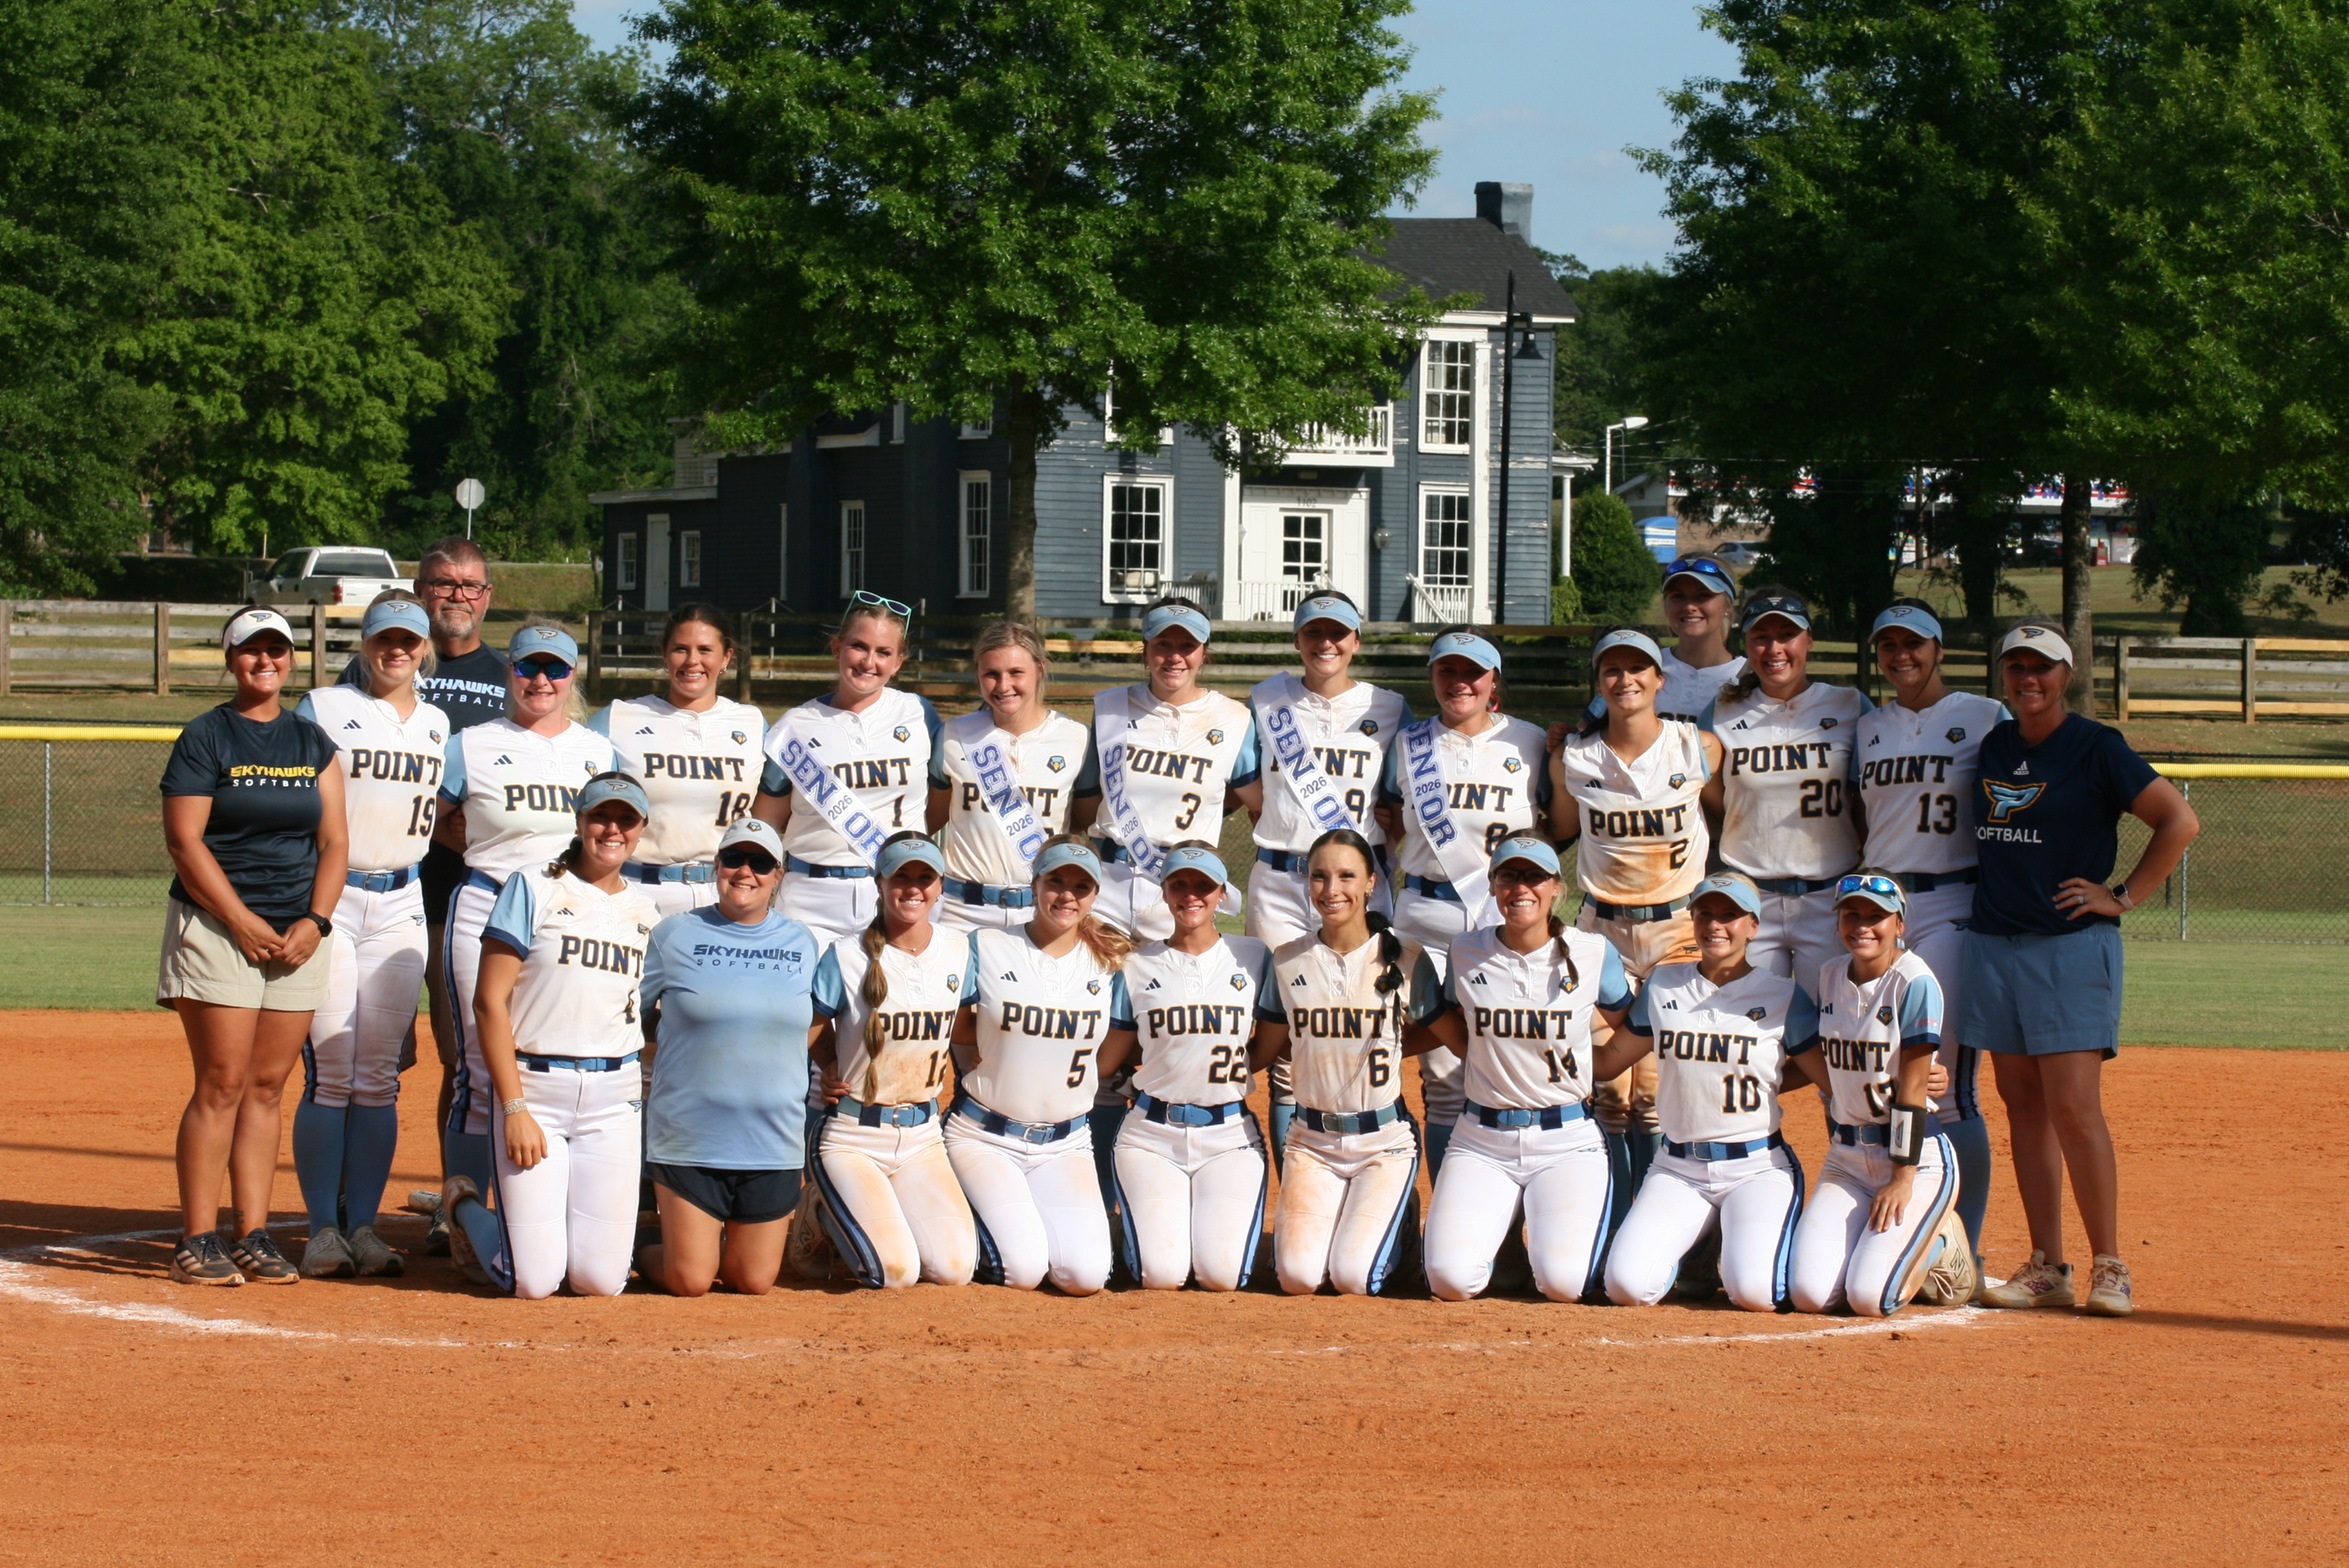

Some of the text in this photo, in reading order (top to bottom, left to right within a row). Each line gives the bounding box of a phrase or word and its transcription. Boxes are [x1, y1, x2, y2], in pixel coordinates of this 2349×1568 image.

[412, 677, 506, 699] KYHAWKS
[419, 693, 505, 711] OFTBALL
[230, 764, 316, 778] SKYHAWKS
[350, 748, 442, 787] POINT
[643, 752, 745, 782] POINT
[826, 757, 911, 790] OINT
[1731, 742, 1832, 776] POINT
[1861, 754, 1954, 791] POINT
[503, 783, 582, 814] POIN
[1299, 775, 1328, 800] 2026
[1414, 779, 1442, 798] 2026
[1799, 778, 1843, 818] 20
[407, 794, 436, 838] 19
[827, 794, 854, 821] 2026
[1174, 792, 1202, 831] 3
[1345, 787, 1365, 824] 9
[1588, 803, 1687, 838] POINT
[1916, 792, 1958, 836] 13
[1005, 814, 1034, 837] 2026
[1121, 816, 1140, 839] 2026
[1974, 826, 2043, 844] OFTBALL
[1668, 837, 1690, 870] 2
[557, 934, 643, 979] POINT
[693, 944, 803, 963] SKYHAWKS
[1000, 1000, 1102, 1040] POINT
[1147, 1004, 1245, 1039] POINT
[1292, 1007, 1387, 1039] POINT
[1474, 1006, 1573, 1040] POINT
[1207, 1045, 1247, 1084] 22
[1543, 1046, 1579, 1083] 14
[1659, 1029, 1758, 1066] POINT
[1066, 1048, 1094, 1089] 5
[1368, 1048, 1390, 1088] 6
[1722, 1073, 1762, 1114] 10
